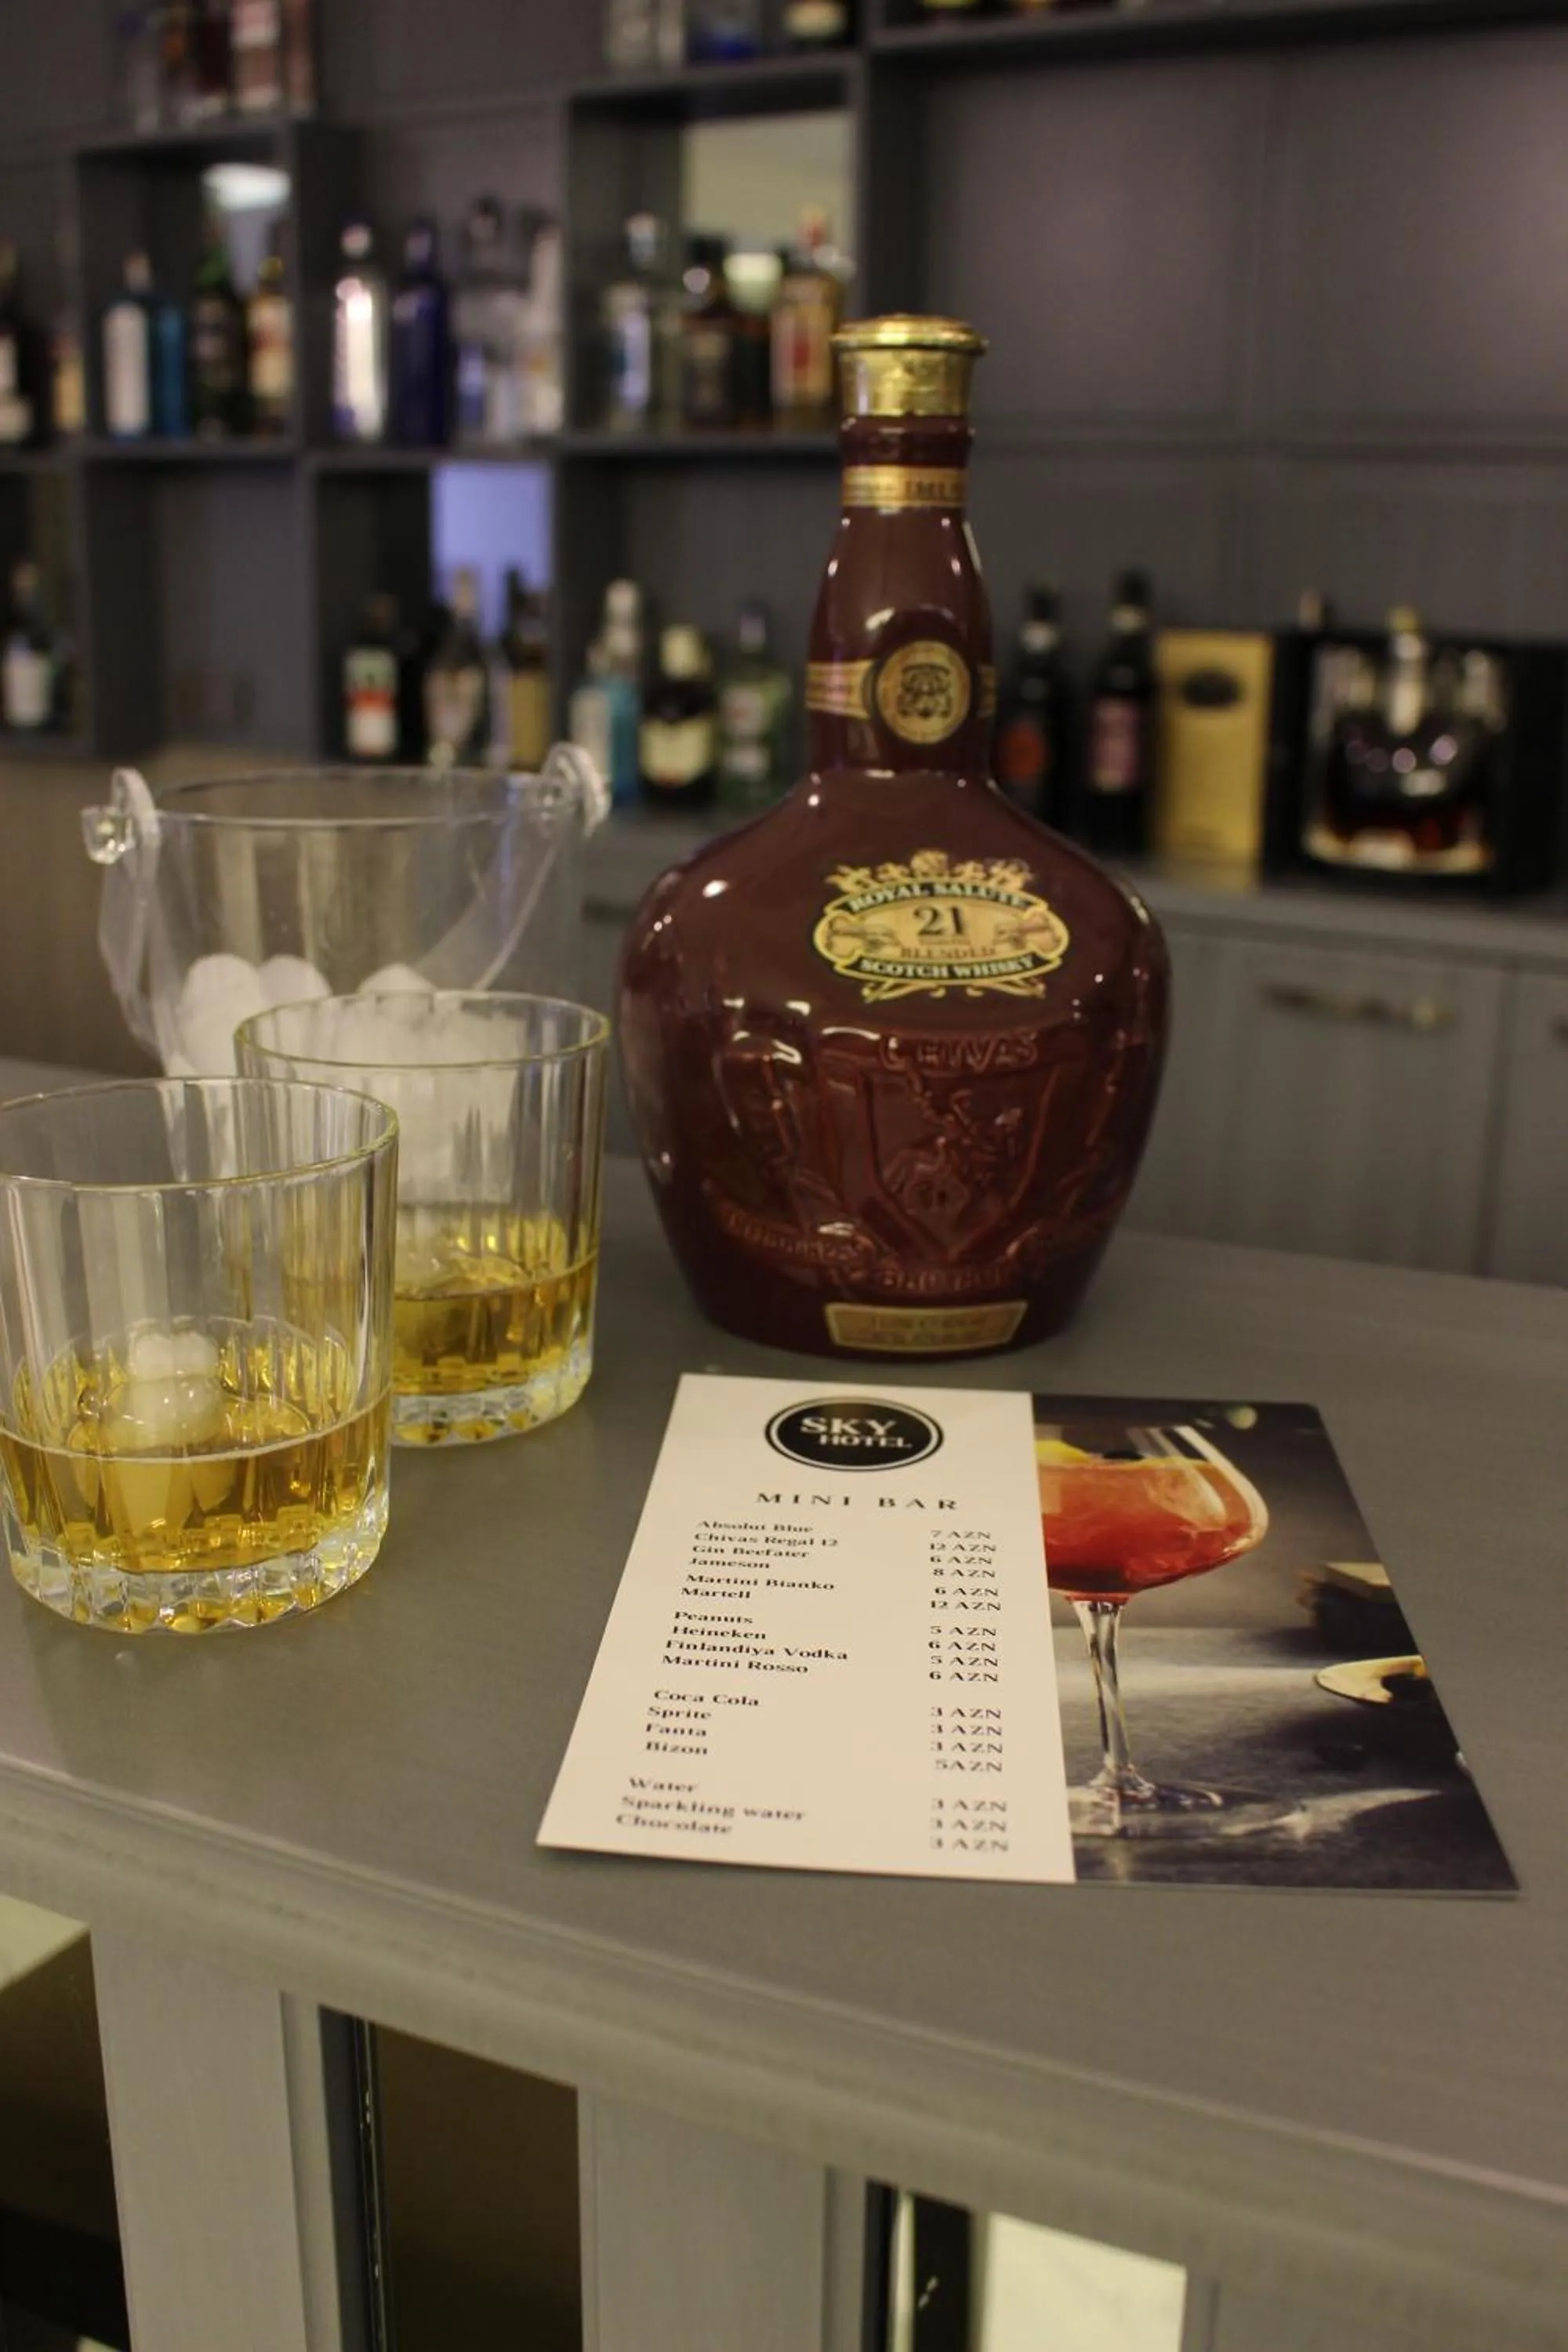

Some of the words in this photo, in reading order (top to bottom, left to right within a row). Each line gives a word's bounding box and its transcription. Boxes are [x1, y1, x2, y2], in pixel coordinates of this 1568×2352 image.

[848, 882, 928, 912] ROYAL
[913, 905, 966, 936] 21
[861, 957, 948, 978] SCOTCH
[953, 955, 1035, 978] WHISKY
[800, 1417, 897, 1436] SKY
[819, 1434, 913, 1448] HOTEL
[756, 1492, 851, 1506] MINI
[878, 1497, 957, 1510] BAR
[695, 1533, 758, 1543] Chivas
[764, 1536, 814, 1546] Regal
[822, 1538, 838, 1547] 12
[948, 1530, 992, 1539] AZN
[692, 1545, 724, 1554] Gin
[953, 1543, 996, 1552] AZN
[690, 1557, 770, 1569] Jameson
[948, 1555, 992, 1565] AZN
[686, 1573, 758, 1586] Martini
[933, 1568, 944, 1577] 8
[951, 1569, 995, 1578] AZN
[681, 1587, 750, 1599] Martell
[935, 1587, 946, 1595] 6
[953, 1588, 999, 1596] AZN
[931, 1600, 948, 1610] 12
[955, 1601, 1001, 1611] AZN
[674, 1611, 753, 1624] Peanuts
[673, 1625, 766, 1639] Heineken
[931, 1625, 942, 1635] 5
[949, 1627, 996, 1636] AZN
[666, 1639, 775, 1657] Finlandiya
[784, 1647, 848, 1660] Vodka
[928, 1641, 941, 1650] 6
[948, 1641, 996, 1651] AZN
[662, 1655, 739, 1669] Martini
[747, 1660, 808, 1673] Rosso
[931, 1655, 942, 1664] 5
[949, 1657, 998, 1667] AZN
[929, 1671, 942, 1680] 6
[949, 1672, 999, 1682] AZN
[654, 1690, 704, 1703] Coca
[713, 1693, 759, 1707] Cola
[648, 1705, 712, 1719] Sprite
[950, 1708, 1001, 1719] AZN
[645, 1723, 707, 1737] Fanta
[951, 1725, 1002, 1736] AZN
[645, 1741, 707, 1755] Bizon
[951, 1742, 1003, 1754] AZN
[629, 1776, 698, 1793] Water
[622, 1795, 735, 1818] Sparkling
[743, 1806, 804, 1821] water
[953, 1799, 1007, 1813] AZN
[616, 1813, 731, 1835] Chocolate
[952, 1818, 1007, 1833] AZN
[952, 1837, 1008, 1853] AZN
